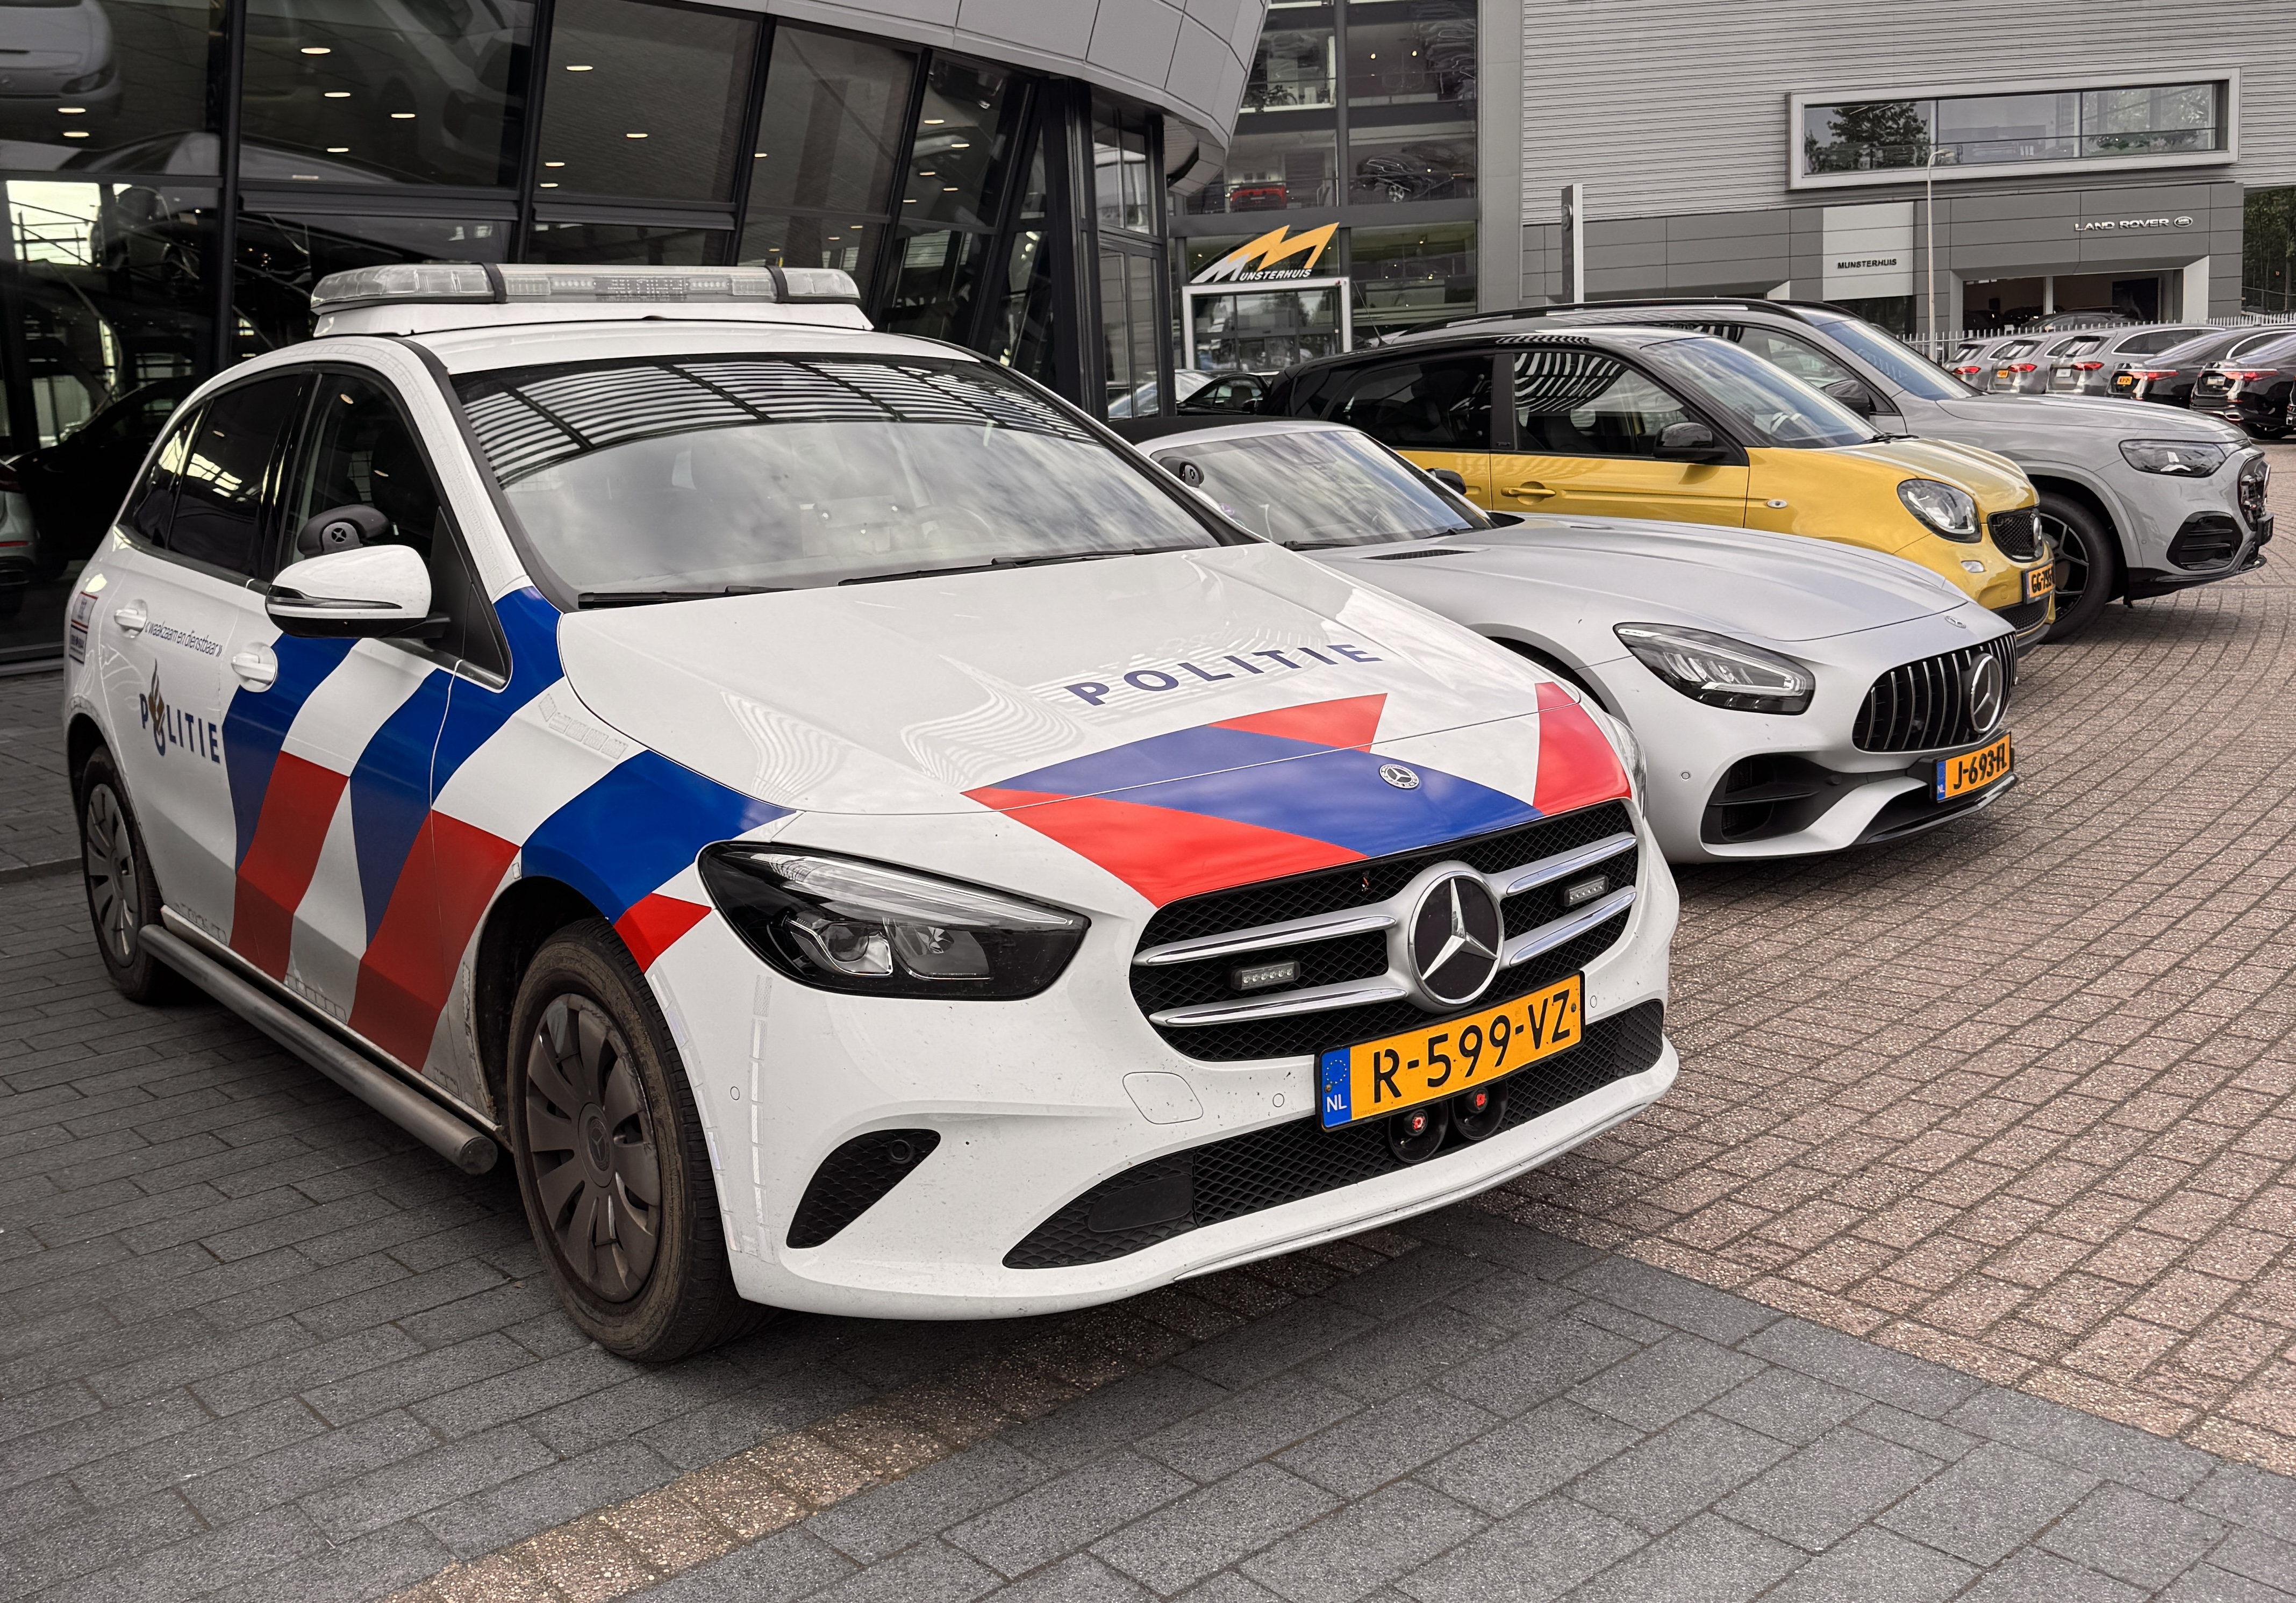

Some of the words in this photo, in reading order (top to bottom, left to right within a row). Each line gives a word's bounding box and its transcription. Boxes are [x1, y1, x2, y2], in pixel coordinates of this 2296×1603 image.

[2075, 221, 2115, 231] LAND
[2119, 218, 2169, 229] ROVER
[1190, 253, 1312, 284] MUNSTERHUIS
[1837, 259, 1897, 269] MUNSTERHUIS
[148, 621, 178, 642] waakzaam
[1063, 644, 1383, 706] POLITIE
[139, 693, 220, 764] POLITIE
[1326, 1093, 1348, 1113] NL
[1373, 989, 1570, 1103] R-599-VZ
